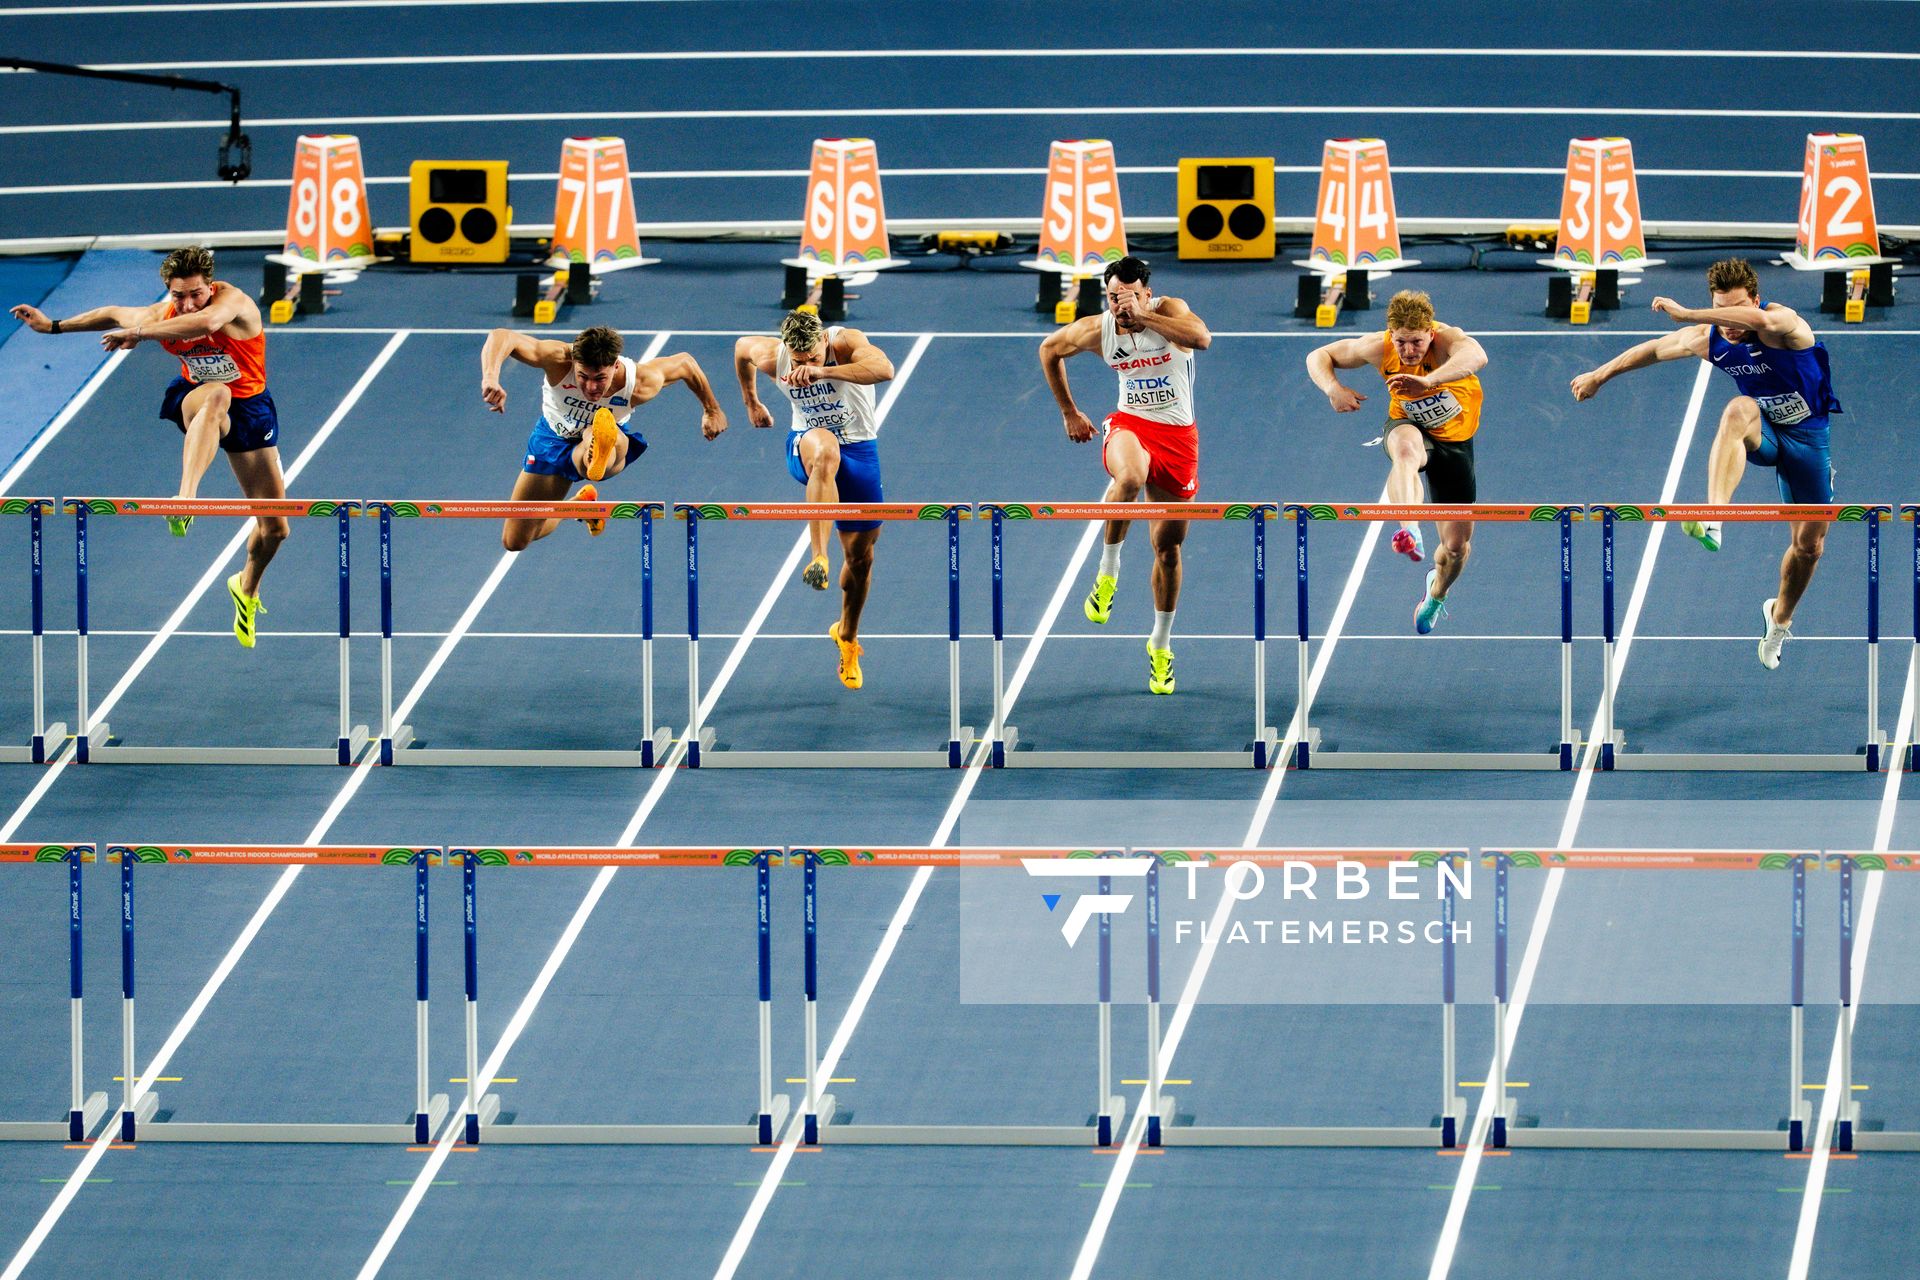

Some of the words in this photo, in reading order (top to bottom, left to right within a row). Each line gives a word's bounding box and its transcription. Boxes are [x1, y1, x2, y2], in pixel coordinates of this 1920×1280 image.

[295, 177, 318, 237] 8
[331, 177, 361, 237] 8
[562, 177, 586, 239] 7
[596, 177, 624, 240] 7
[810, 180, 835, 240] 6
[847, 180, 877, 240] 6
[1048, 180, 1073, 242] 5
[1086, 180, 1115, 242] 5
[1321, 180, 1346, 242] 4
[1359, 179, 1389, 240] 4
[1566, 179, 1592, 240] 3
[1605, 179, 1633, 240] 3
[1800, 174, 1813, 236] 2
[1824, 175, 1863, 237] 2
[1208, 243, 1243, 252] SEIKO
[789, 382, 836, 399] CZECHIA
[1110, 352, 1172, 371] FRANCE
[1134, 375, 1171, 390] TDK
[1724, 362, 1772, 376] ESTONIA
[809, 399, 845, 413] TDK
[1127, 388, 1175, 405] BASTIEN
[1412, 391, 1449, 410] TDK
[1413, 404, 1452, 423] EITEL
[1761, 394, 1798, 408] TDK
